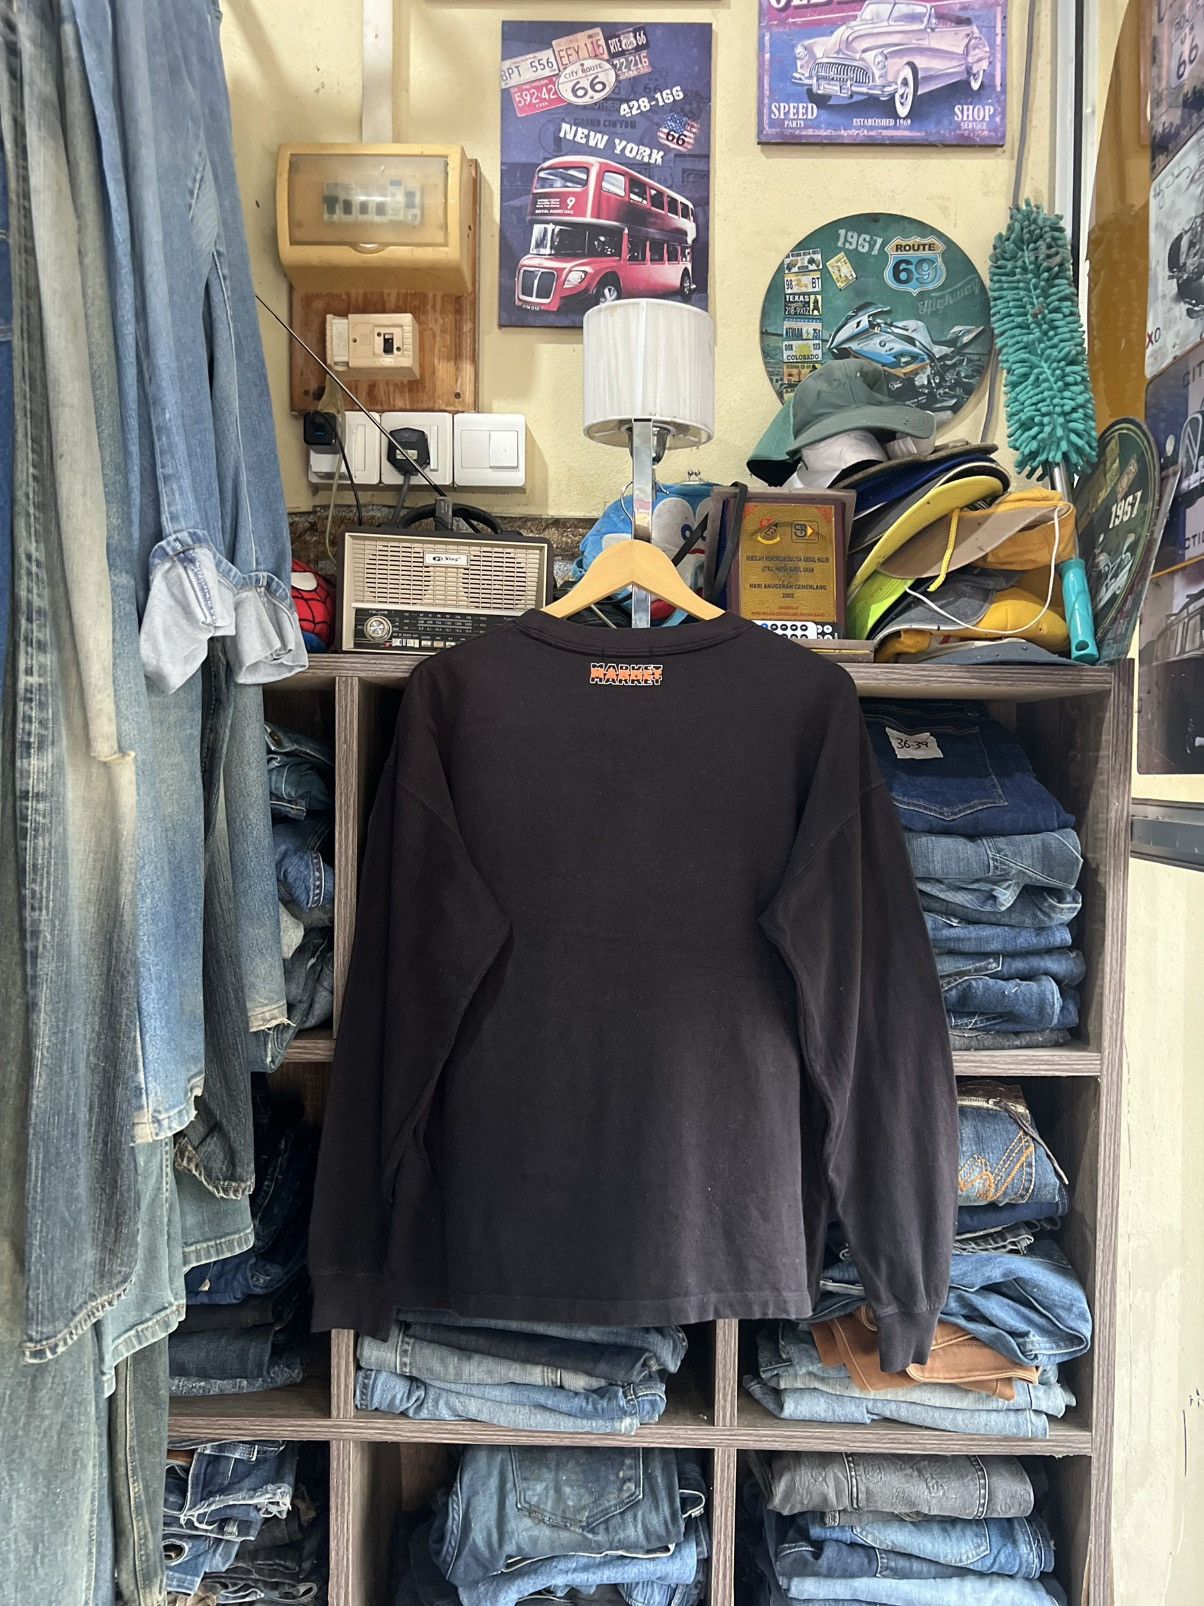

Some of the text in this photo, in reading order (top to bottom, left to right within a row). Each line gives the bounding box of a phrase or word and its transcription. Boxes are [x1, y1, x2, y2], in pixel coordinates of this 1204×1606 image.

[636, 30, 647, 46] 66
[529, 57, 554, 73] 556
[630, 53, 650, 69] 216
[564, 63, 603, 80] CITY ROUTE
[570, 75, 607, 99] 66
[620, 86, 684, 117] 428-166
[771, 102, 994, 120] SPEED SHOP
[784, 120, 805, 128] PARTS
[853, 118, 895, 126] ESTABLISHED
[559, 122, 665, 166] NEW YORK
[665, 129, 688, 147] 66
[566, 196, 576, 210] 9
[838, 229, 884, 255] 1967
[895, 243, 935, 252] ROUTE
[892, 258, 938, 285] 69
[785, 278, 793, 290] 98
[785, 294, 810, 302] TEXAS
[1108, 489, 1143, 529] 1967
[590, 662, 663, 686] MARKET
